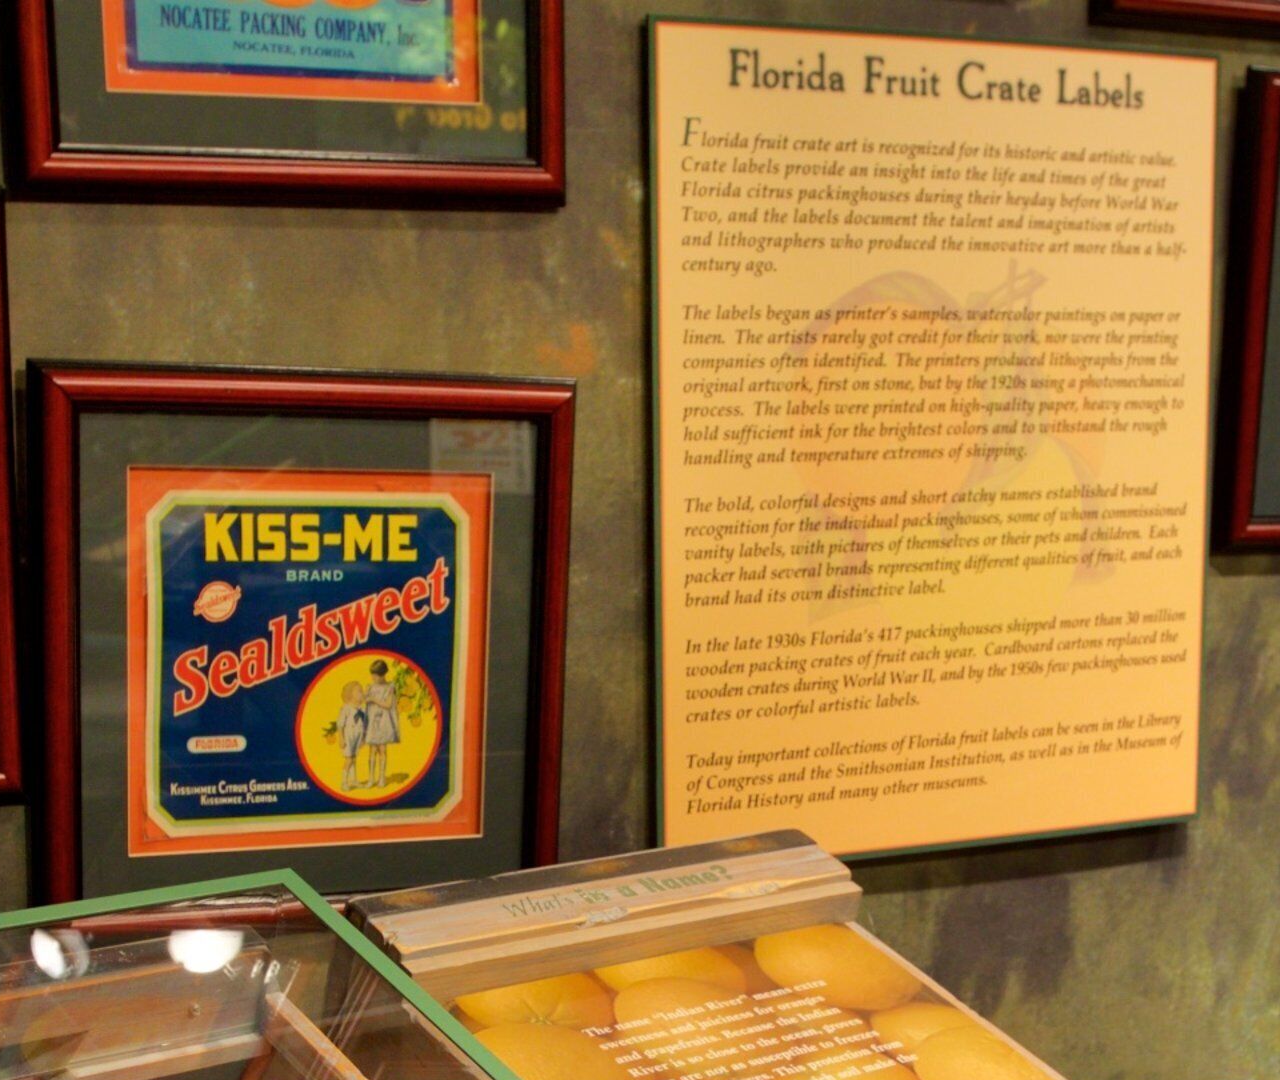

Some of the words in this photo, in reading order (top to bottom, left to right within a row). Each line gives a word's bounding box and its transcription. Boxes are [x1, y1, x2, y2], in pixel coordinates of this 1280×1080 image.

[160, 5, 231, 32] NOCATEE
[240, 10, 307, 39] PACKING
[315, 16, 390, 46] COMPANY,
[300, 43, 356, 60] FLORIDA
[729, 48, 844, 92] Florida
[864, 55, 939, 96] Fruit
[956, 61, 1041, 102] Crate
[1057, 68, 1143, 108] Labels
[680, 120, 748, 148] Florida
[752, 132, 788, 153] fruit
[792, 137, 831, 152] crate
[834, 138, 858, 152] art
[861, 138, 874, 153] is
[878, 140, 955, 159] recognized
[957, 141, 980, 160] for
[982, 143, 1001, 158] its
[1004, 143, 1056, 160] historic
[1059, 147, 1086, 162] and
[1088, 150, 1135, 164] artistic
[1139, 152, 1175, 166] value.
[680, 156, 726, 173] Crate
[731, 157, 779, 174] labels
[783, 160, 845, 179] provide
[848, 166, 868, 177] an
[873, 163, 925, 183] insight
[930, 165, 960, 180] into
[965, 165, 988, 181] the
[992, 166, 1015, 186] life
[1018, 168, 1046, 183] and
[1049, 171, 1086, 185] times
[1090, 171, 1105, 189] of
[1108, 172, 1129, 187] the
[1132, 176, 1166, 192] great
[680, 180, 741, 197] Florida
[746, 184, 793, 199] citrus
[797, 185, 910, 205] packinghouses
[914, 187, 963, 208] during
[967, 189, 1002, 205] their
[1005, 190, 1055, 211] heyday
[1059, 192, 1101, 211] before
[1106, 194, 1147, 210] World
[1151, 196, 1178, 211] War
[204, 513, 418, 563] KISS-ME
[286, 570, 344, 582] BRAND
[173, 556, 451, 718] Sealdsweet
[686, 795, 741, 814] Florida
[746, 793, 803, 808] History
[807, 785, 835, 802] and
[839, 786, 878, 800] many
[882, 779, 919, 795] other
[922, 776, 986, 790] museums.
[617, 884, 638, 897] a
[635, 864, 734, 894] Name?
